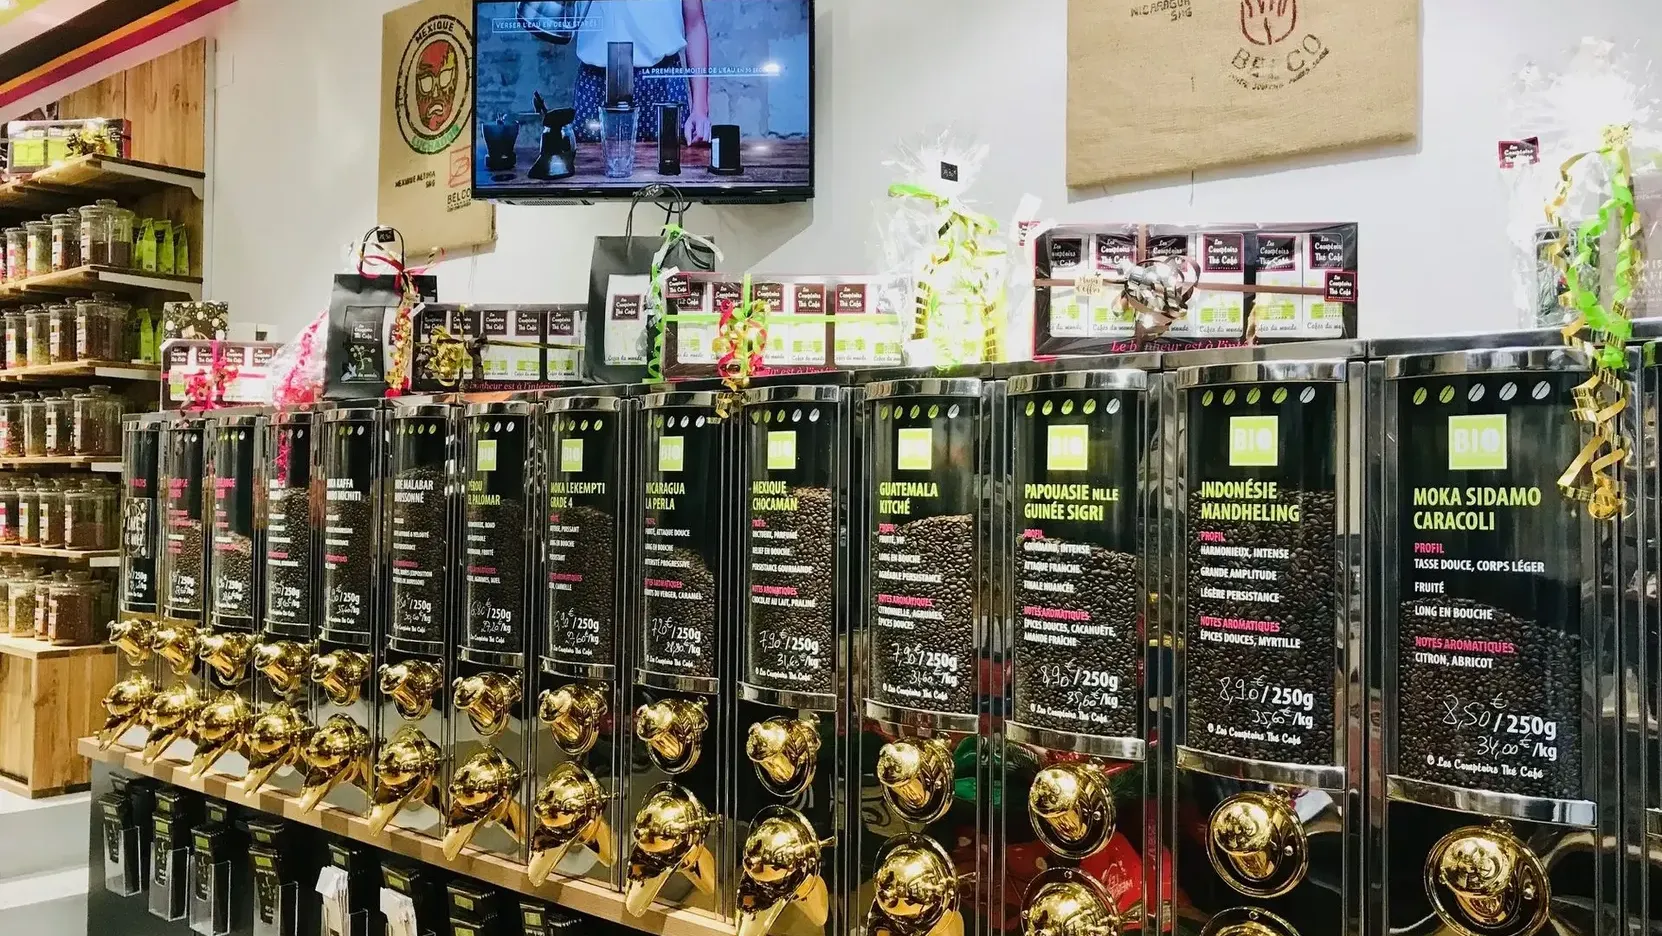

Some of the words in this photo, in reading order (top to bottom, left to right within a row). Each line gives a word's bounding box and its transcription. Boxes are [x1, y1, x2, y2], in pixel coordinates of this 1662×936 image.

[415, 20, 455, 43] MEXIQUE
[496, 21, 521, 29] VERSER
[1110, 340, 1126, 352] Le
[1185, 341, 1203, 350] est
[1234, 428, 1273, 452] BIO
[1454, 428, 1500, 453] BIO
[566, 482, 605, 494] LEKEMPTI
[645, 482, 685, 494] NICARAGUA
[753, 481, 786, 495] MEXIQUE
[880, 482, 938, 497] GUATEMALA
[1024, 484, 1089, 500] PAPOUASIE
[1092, 488, 1119, 500] NLLE
[1201, 478, 1277, 499] INDONÉSIE
[568, 496, 573, 508] 4
[645, 497, 652, 509] LA
[653, 498, 675, 510] PERLA
[753, 497, 798, 511] CHOCAMAN
[1413, 488, 1461, 506] MOKA
[1466, 487, 1542, 506] SIDAMO
[880, 498, 911, 515] KITCHÉ
[1024, 501, 1065, 520] GUINÉE
[1067, 505, 1104, 521] SIGRI
[1201, 503, 1300, 522] MANDHELING
[1413, 511, 1495, 530] CARACOLI
[1200, 531, 1225, 542] PROFIL
[1200, 545, 1252, 558] HARMONIEUX,
[1253, 548, 1289, 559] INTENSE
[1414, 543, 1444, 554] PROFIL
[1414, 558, 1439, 570] TASSE
[1440, 560, 1474, 573] DOUCE,
[1477, 560, 1509, 571] CORPS
[1512, 559, 1545, 572] LÉGER
[1200, 567, 1229, 578] GRANDE
[1229, 569, 1277, 581] AMPLITUDE
[1200, 586, 1226, 599] LÉGÈRE
[1226, 590, 1280, 603] PERSISTANCE
[1414, 580, 1444, 594] FRUITÉ
[1415, 605, 1437, 617] LONG
[1439, 607, 1451, 618] EN
[1453, 608, 1493, 620] BOUCHE
[1024, 619, 1042, 630] ÉPICES
[1043, 620, 1070, 633] DOUCES,
[1200, 616, 1222, 628] NOTES
[1222, 618, 1280, 632] AROMATIQUES
[1024, 632, 1048, 644] AMANDE
[1049, 633, 1077, 646] FRAÎCHE
[1200, 629, 1223, 642] ÉPICES
[1224, 632, 1256, 647] DOUCES,
[1258, 636, 1300, 649] MYRTILLE
[1415, 636, 1442, 648] NOTES
[1443, 638, 1514, 654] AROMATIQUES
[1415, 653, 1449, 667] CITRON,
[1451, 656, 1493, 668] ABRICOT
[1437, 756, 1452, 768] Les
[1454, 759, 1499, 775] Comptoirs
[1501, 763, 1517, 777] Thé
[1520, 765, 1544, 779] Café
